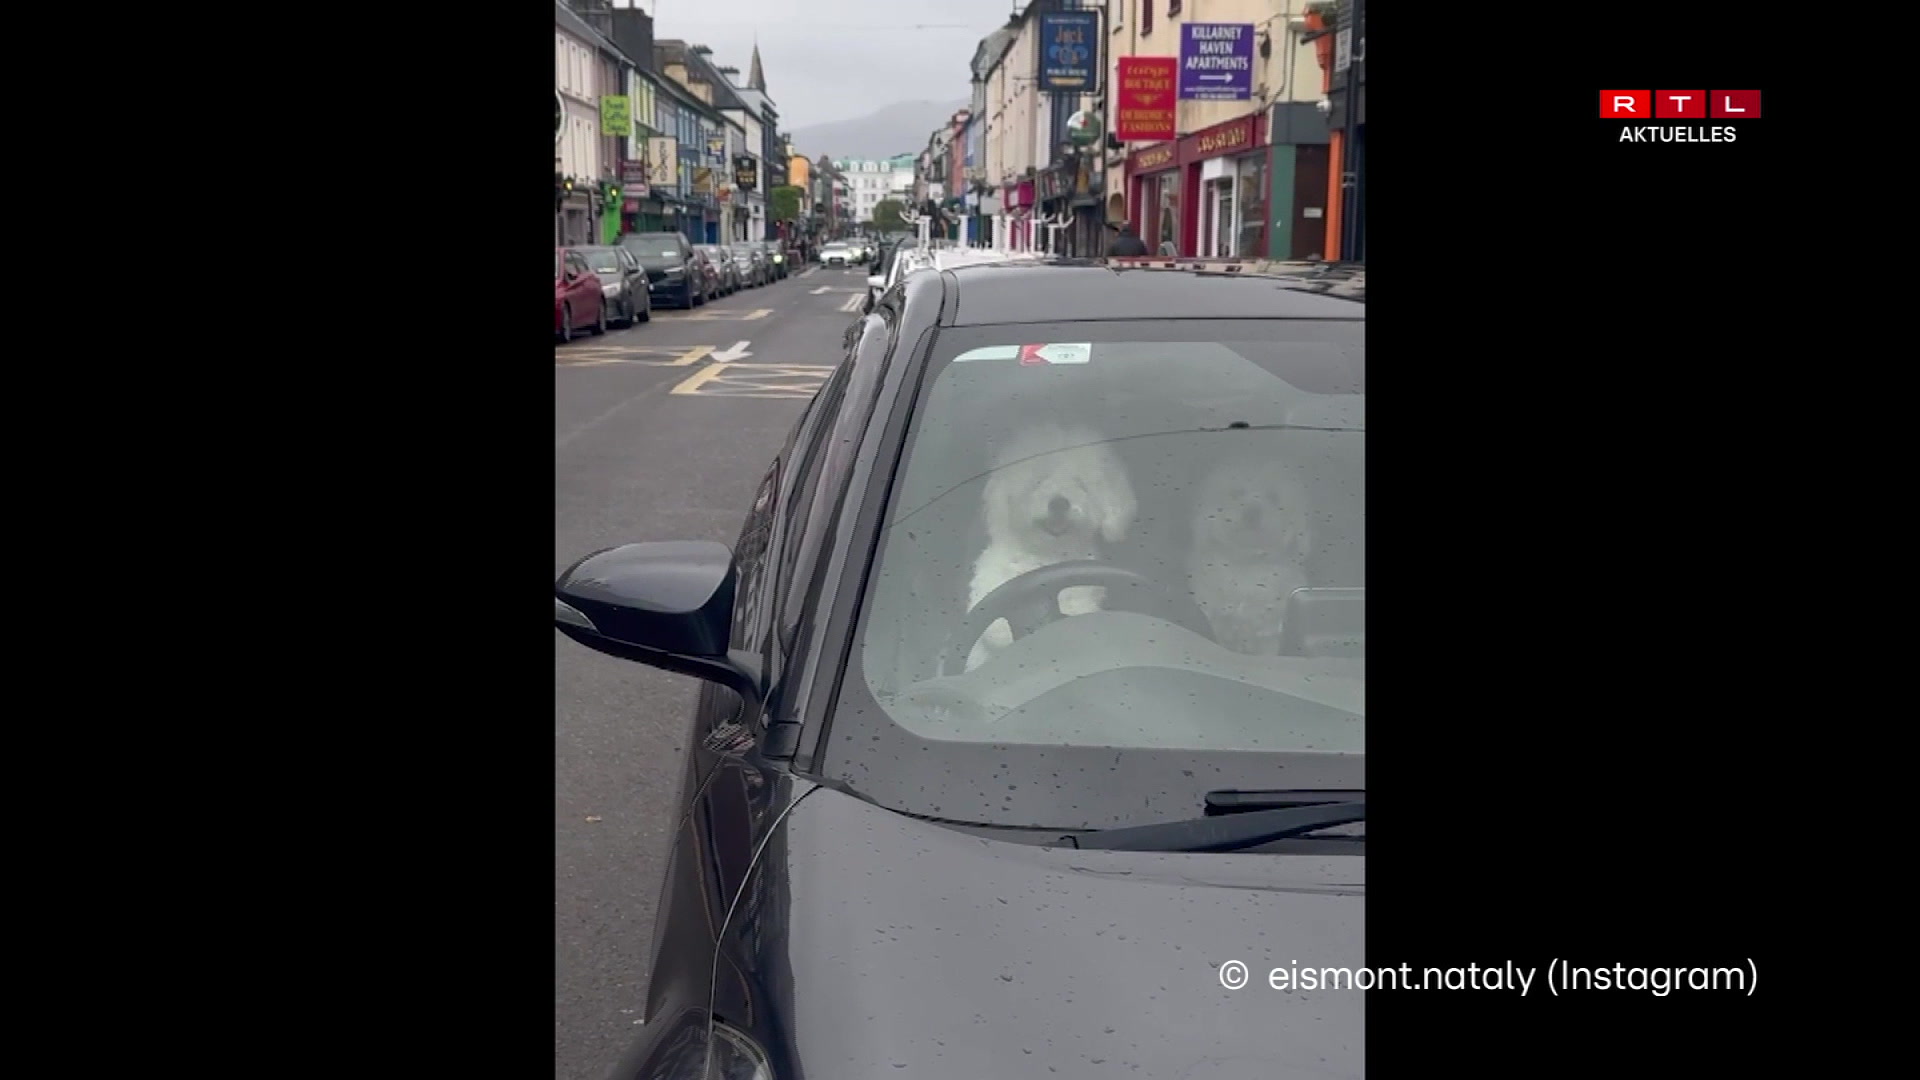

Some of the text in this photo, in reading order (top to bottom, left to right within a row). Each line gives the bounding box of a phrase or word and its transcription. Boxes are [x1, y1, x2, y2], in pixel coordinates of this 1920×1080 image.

[1192, 26, 1242, 41] KILLARNEY
[1199, 41, 1233, 55] HAVEN
[1185, 56, 1248, 70] APARTMENTS
[1123, 121, 1172, 132] FASHIONS
